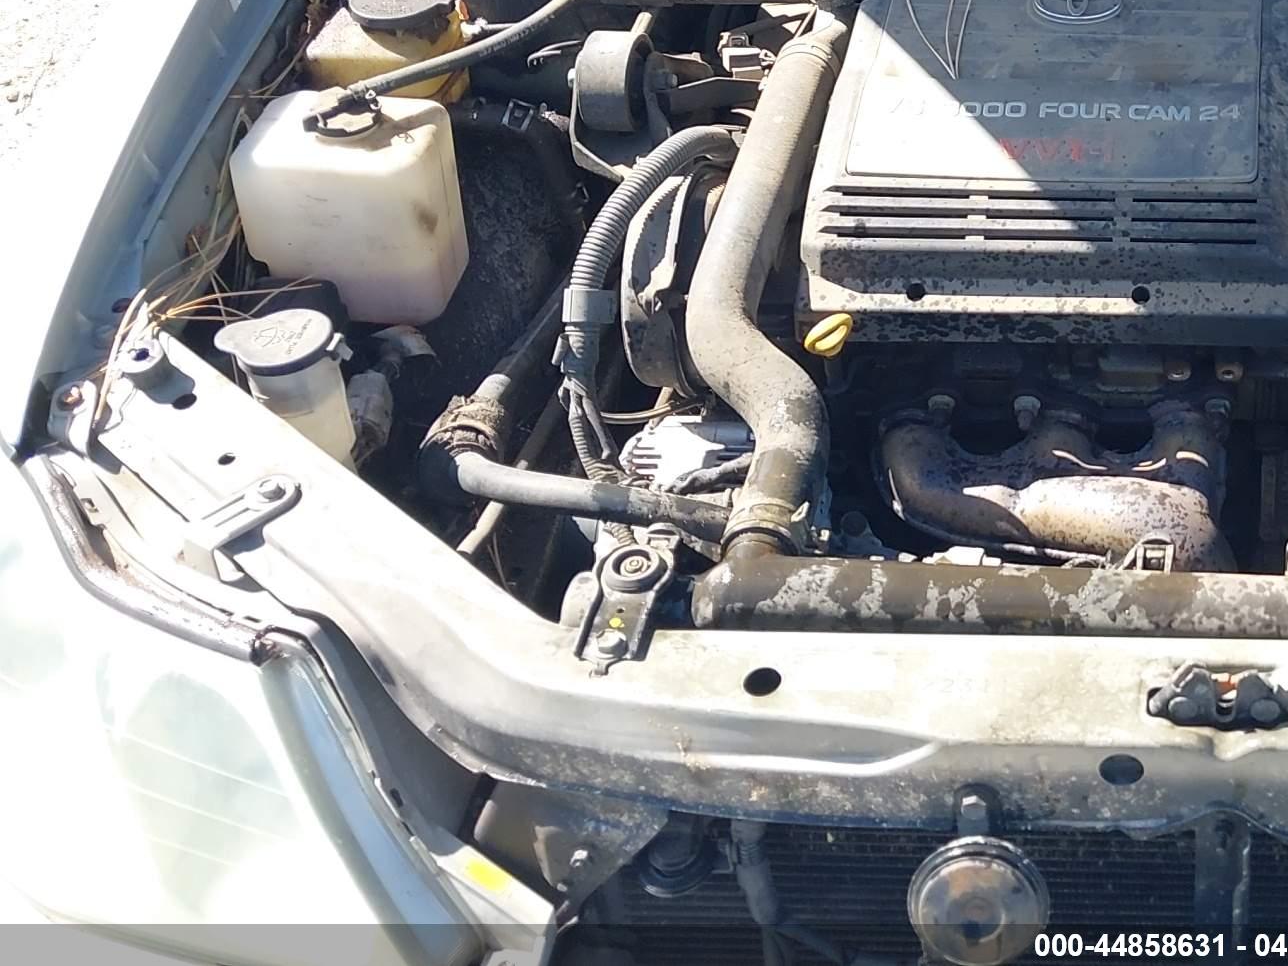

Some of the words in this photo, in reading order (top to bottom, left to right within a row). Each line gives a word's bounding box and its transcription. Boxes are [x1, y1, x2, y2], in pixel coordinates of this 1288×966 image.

[940, 100, 1027, 118] 000
[1039, 101, 1121, 119] FOUR
[1128, 104, 1191, 121] CAM
[1199, 103, 1241, 121] 24
